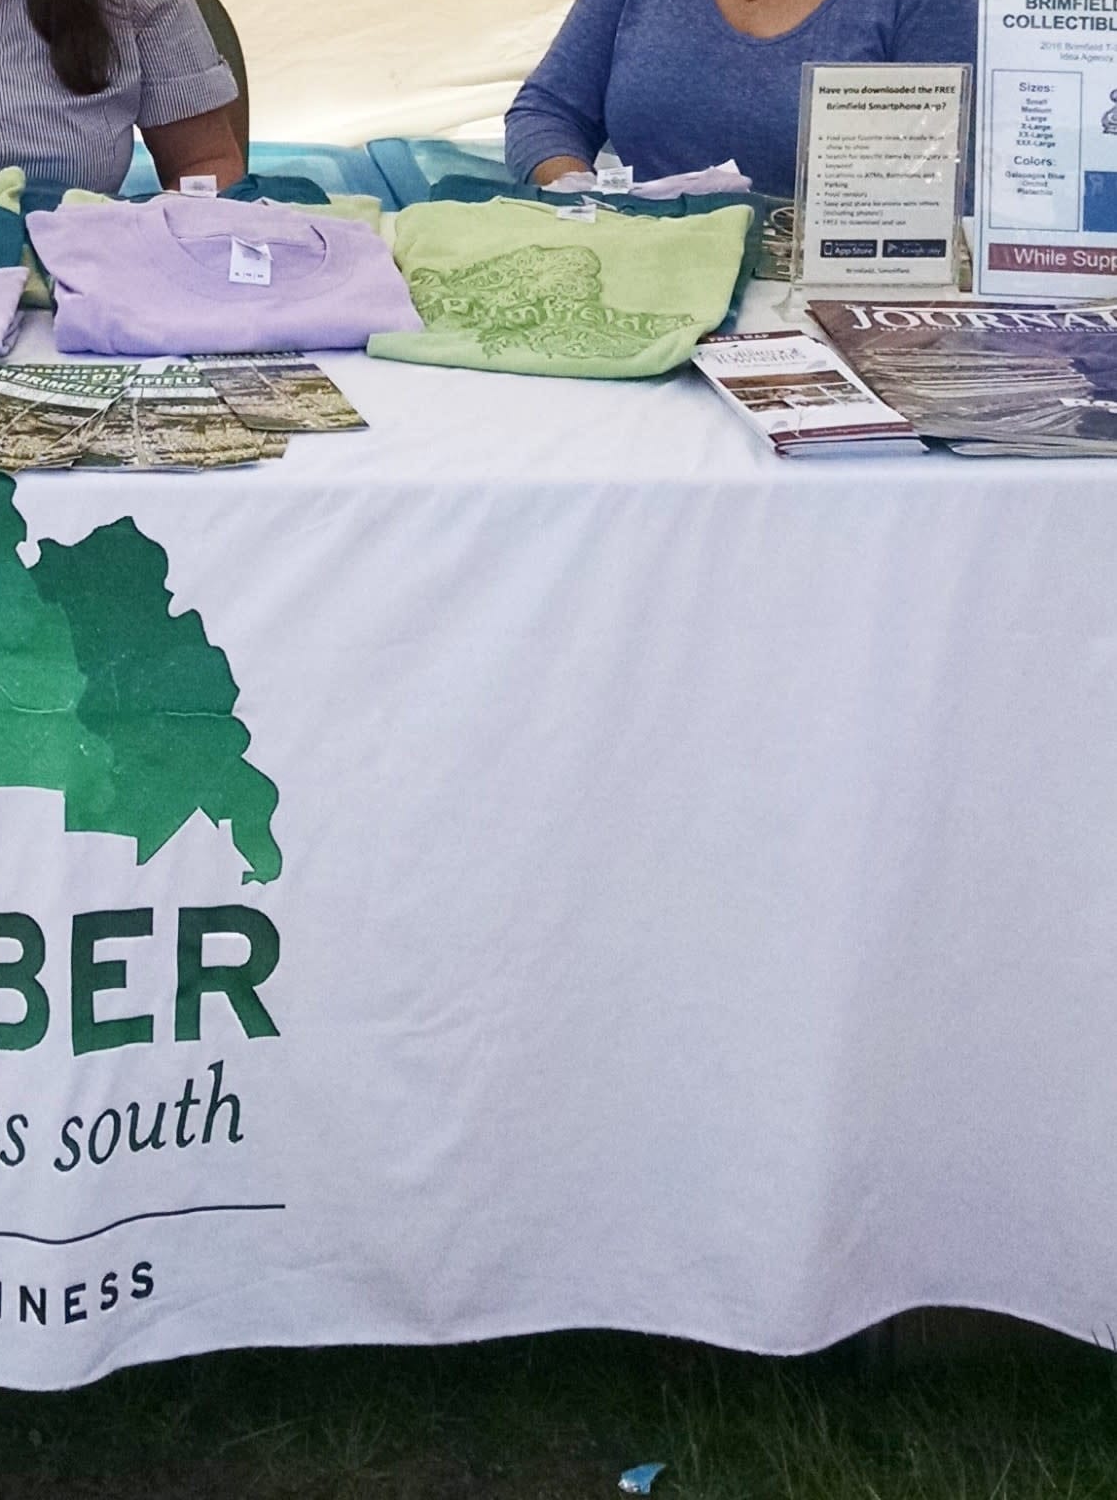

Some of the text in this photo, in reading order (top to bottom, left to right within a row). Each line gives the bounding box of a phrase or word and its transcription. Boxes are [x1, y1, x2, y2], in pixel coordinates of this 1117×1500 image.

[818, 85, 955, 96] Have you downloaded the FREE
[1019, 82, 1056, 92] Sizes:
[827, 102, 866, 110] Brimfield
[868, 102, 921, 112] Smartphone
[1013, 156, 1056, 167] Colors:
[1014, 248, 1067, 266] While
[17, 373, 120, 394] BRIMFIELD
[53, 1059, 245, 1174] south
